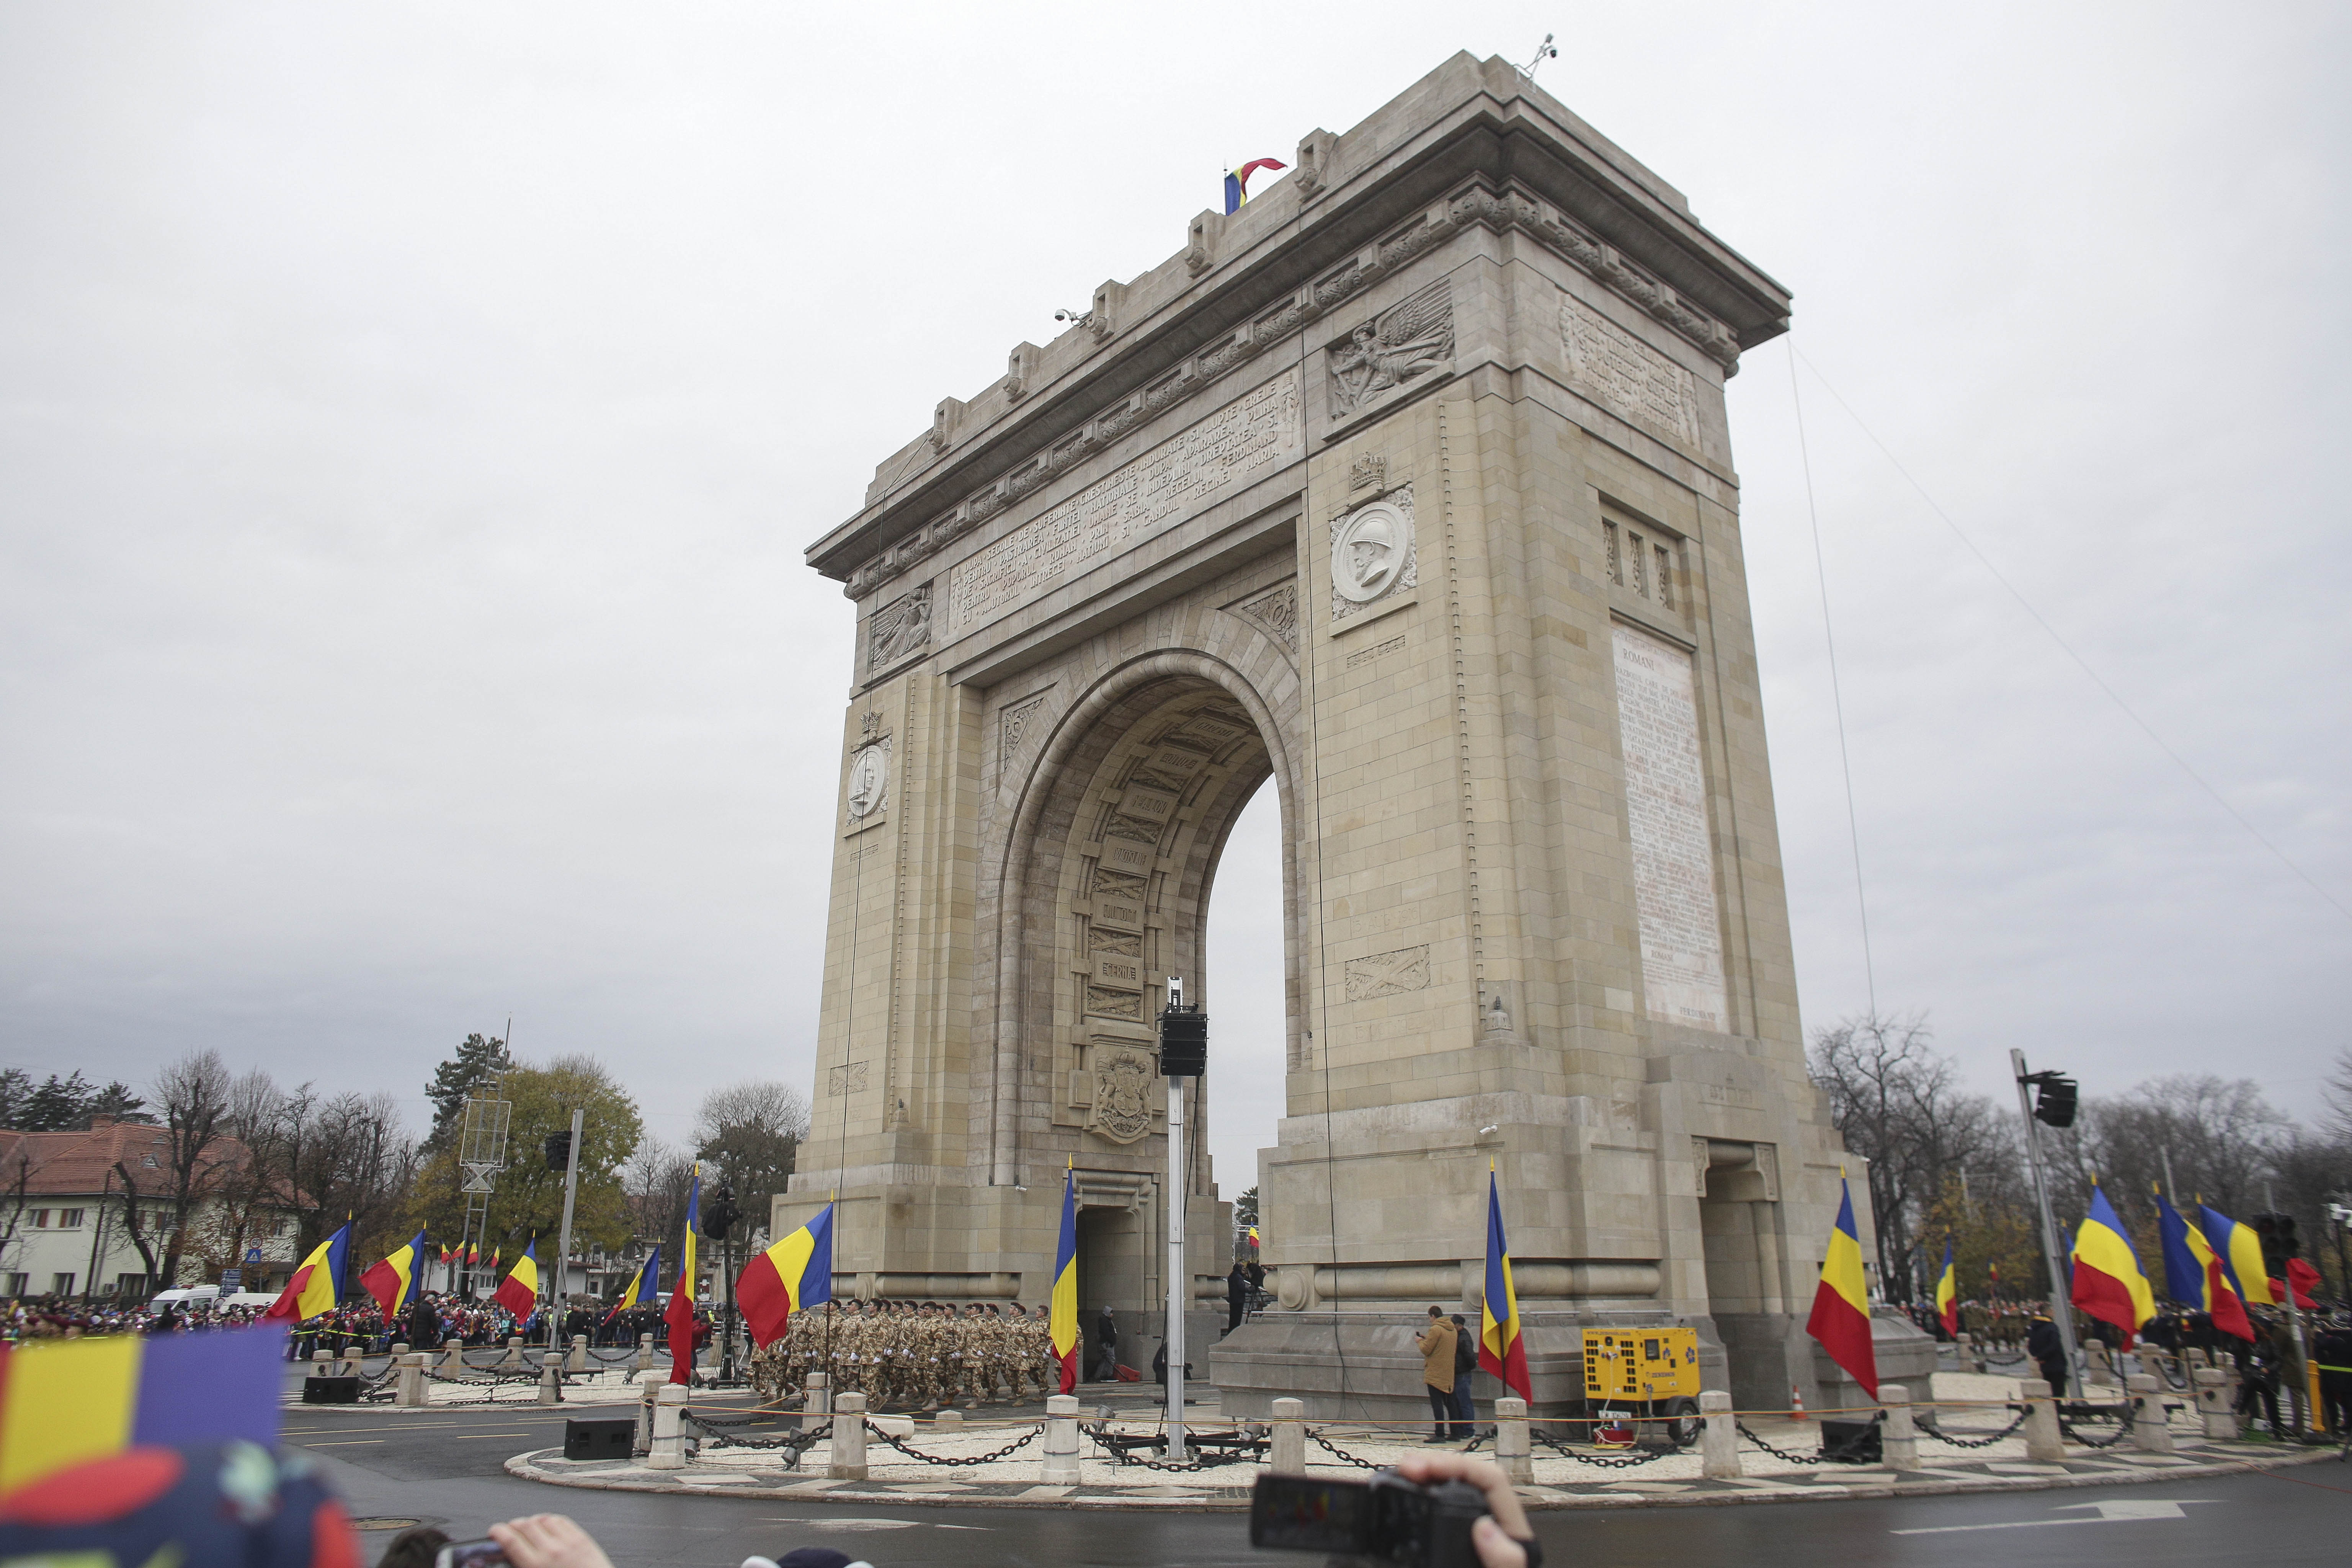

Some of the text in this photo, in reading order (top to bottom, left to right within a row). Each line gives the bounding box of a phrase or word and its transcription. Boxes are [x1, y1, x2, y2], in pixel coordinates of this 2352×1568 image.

[962, 611, 972, 625] CU
[1030, 559, 1065, 589] INTREGEI
[1076, 536, 1109, 563] NATIUNI
[1121, 524, 1130, 539] SI
[1144, 498, 1179, 526] GANDUL
[1194, 468, 1231, 500] REGINEI
[1246, 445, 1280, 472] MARIA
[963, 412, 1278, 599] DE SACRIFICII A CIVILIZATIEI UMANE SE INDEPLINI DREPTATEA SI
[963, 430, 1277, 612] PENTRU POPORUL ROMAN PRIN SABIA REGELUI FERDINAND
[964, 382, 1277, 573] DUPA SECOLE DE SUFERINTE CRESTINESTE INDURATE SI LUPTE GRELE
[964, 398, 1279, 586] PENTRU PASTRAREA FIINTEI NATIONALE DUPA APARAREA PLINA
[1623, 648, 1654, 670] ROMANI
[1113, 847, 1147, 866] DRAGOSLAVE
[1106, 964, 1130, 980] CERNA
